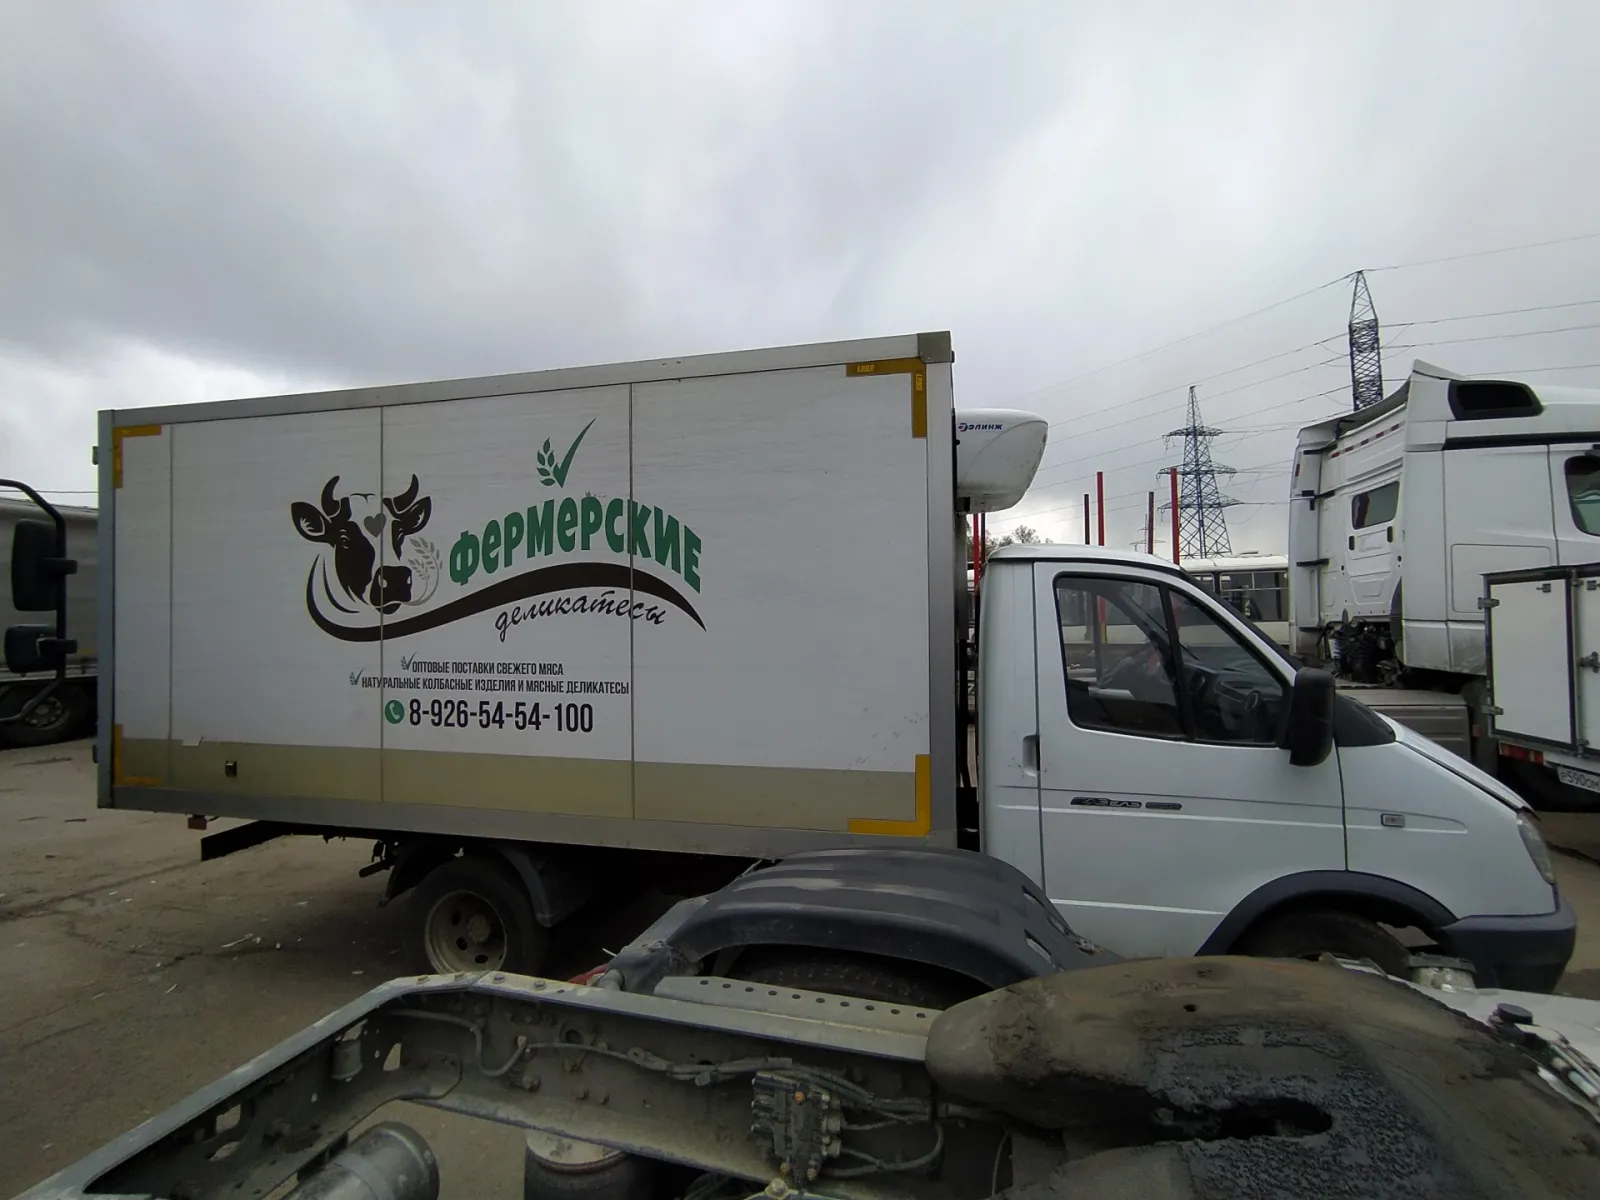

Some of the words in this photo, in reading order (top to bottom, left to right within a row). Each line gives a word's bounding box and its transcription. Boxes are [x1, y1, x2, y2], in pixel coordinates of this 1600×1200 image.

[495, 590, 666, 642] деликатесы
[411, 661, 450, 673] ОПТОВЫЕ
[451, 662, 495, 674] ПОСТАВКИ
[496, 662, 537, 675] СВЕЖЕГО
[538, 663, 564, 675] МЯСА
[361, 677, 421, 689] НАТУРАЛЬНЫЕ
[422, 678, 473, 691] КОЛБАСНЫЕ
[475, 679, 516, 692] ИЗДЕЛИЯ
[518, 679, 524, 692] И
[526, 680, 564, 693] МЯСНЫЕ
[566, 681, 630, 694] ДЕЛИКАТЕСЫ
[409, 698, 593, 733] 8-926-54-54-100
